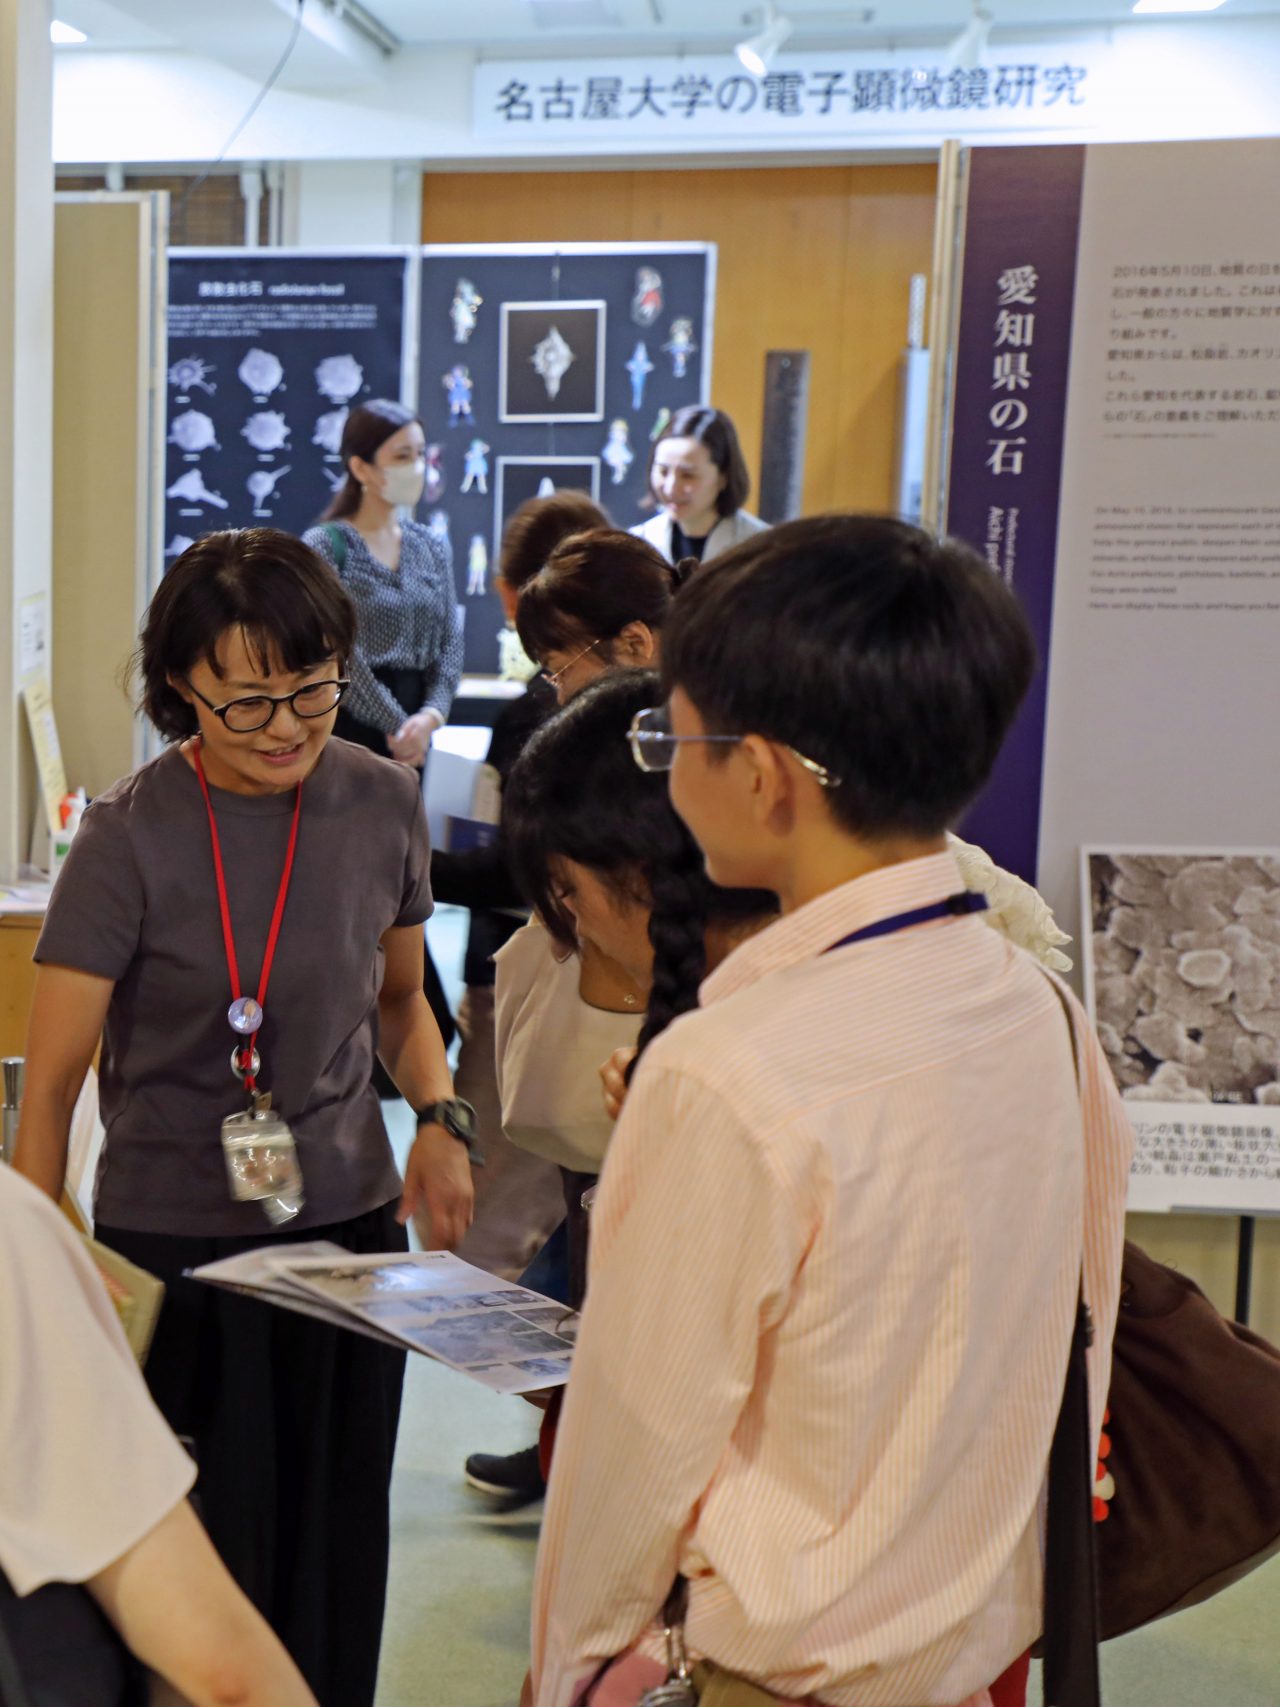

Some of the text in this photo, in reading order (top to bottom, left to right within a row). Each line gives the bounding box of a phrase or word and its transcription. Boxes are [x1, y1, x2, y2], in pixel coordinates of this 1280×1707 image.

[497, 64, 1087, 122] 名古屋大学の電子顕微鏡研究
[985, 265, 1039, 476] 愛知県の石
